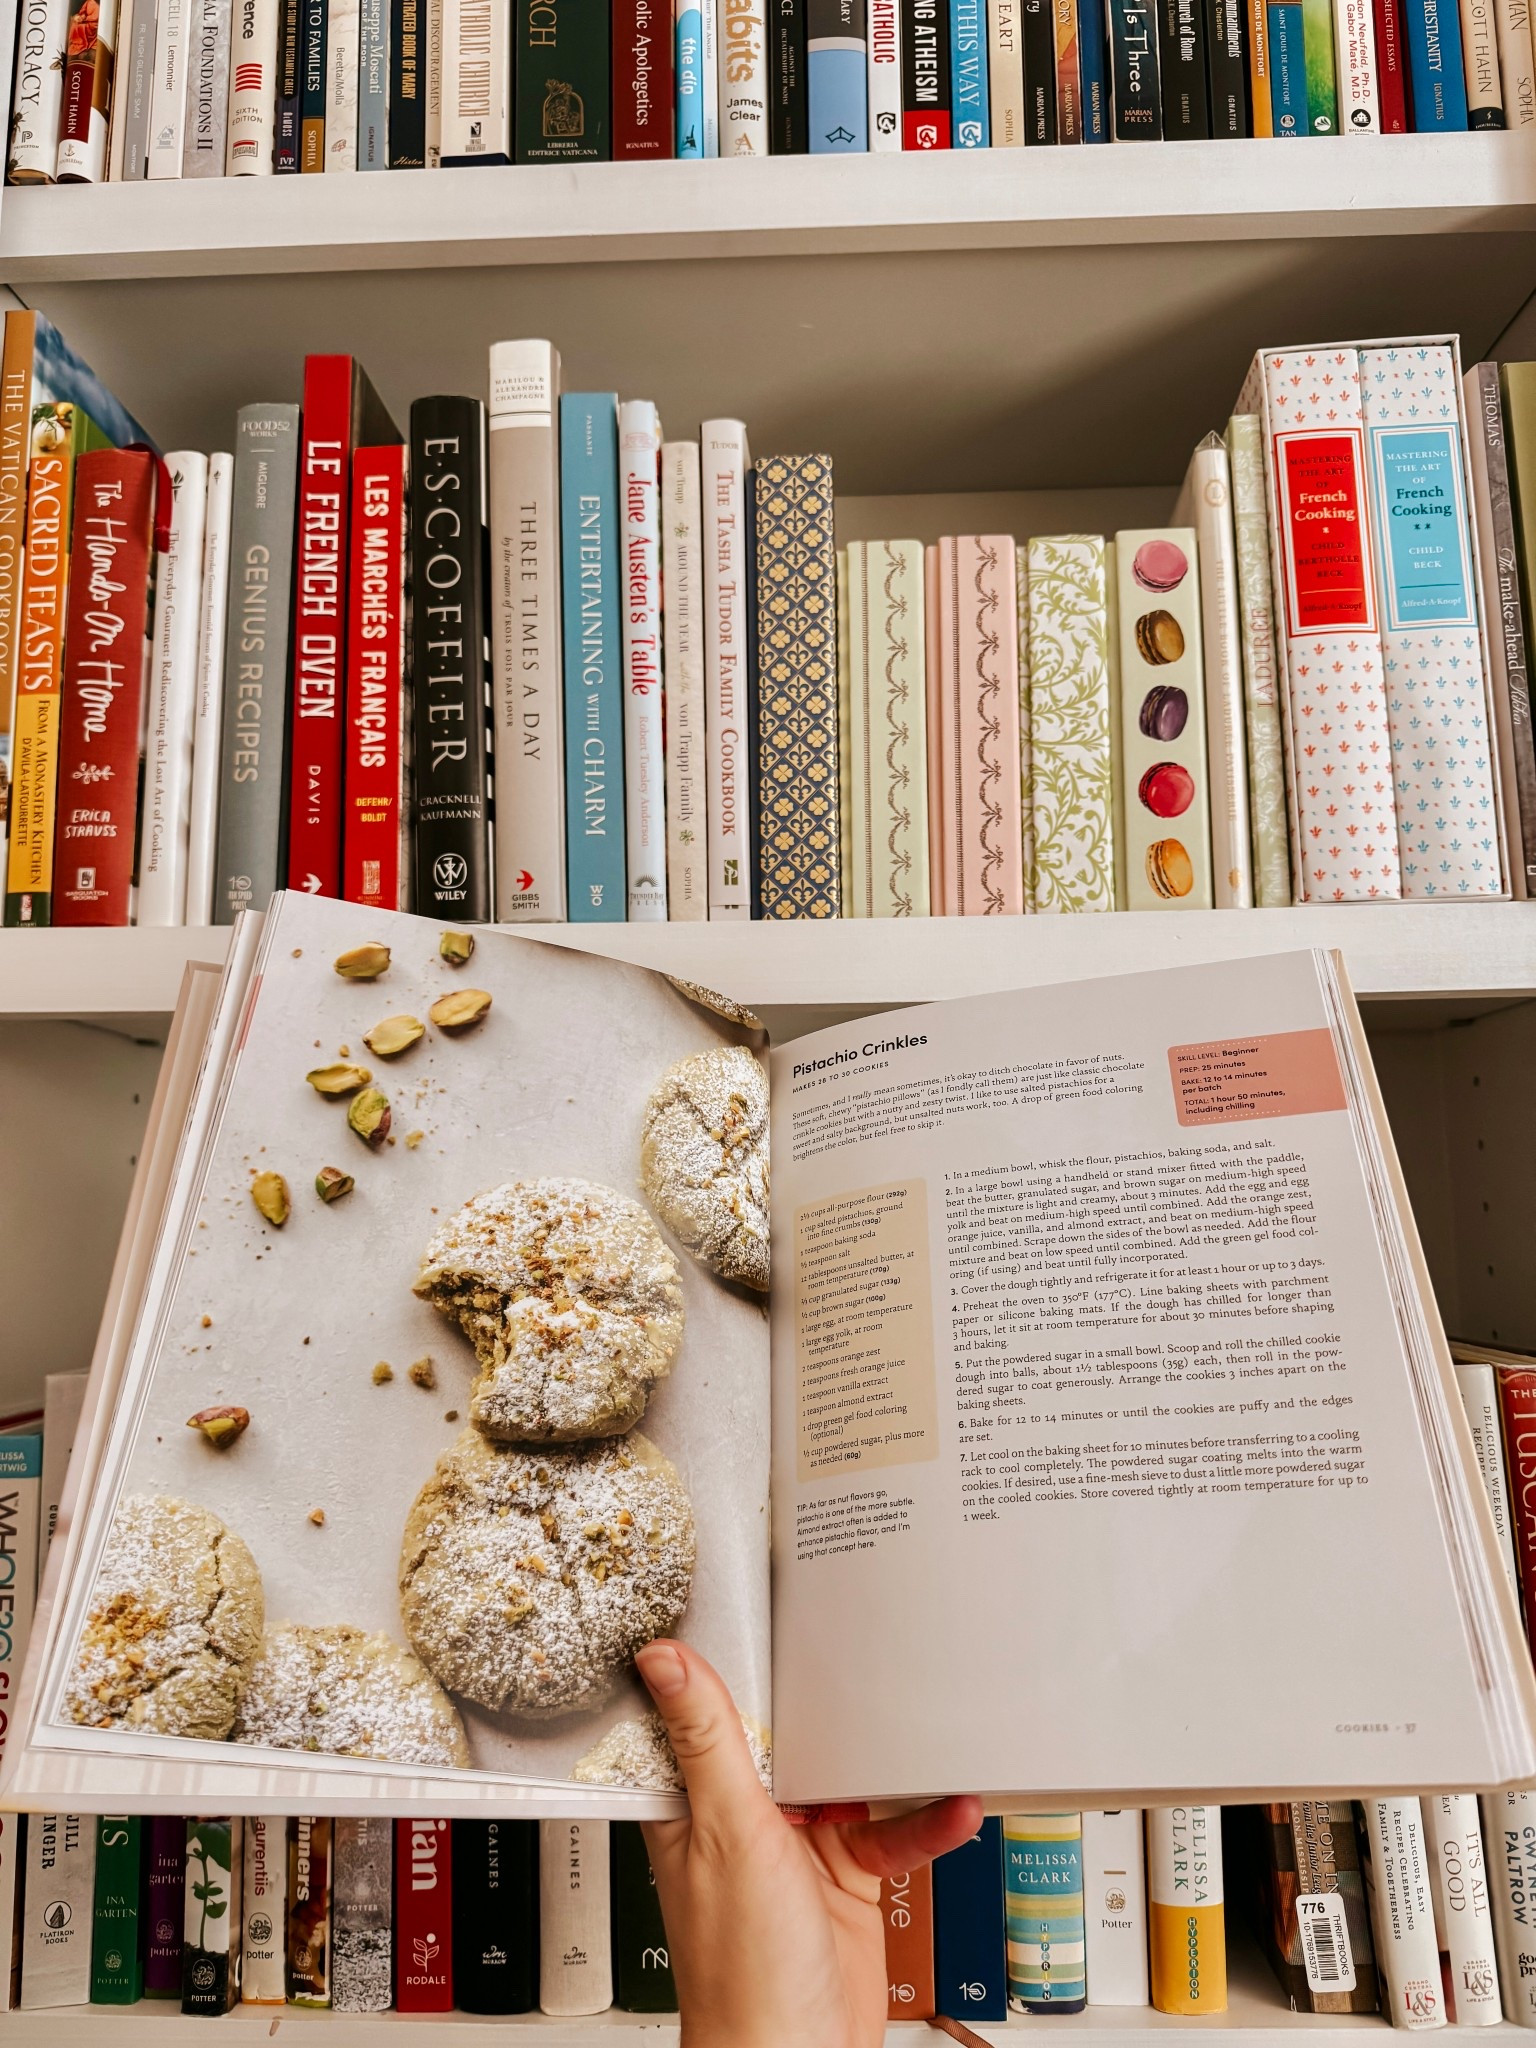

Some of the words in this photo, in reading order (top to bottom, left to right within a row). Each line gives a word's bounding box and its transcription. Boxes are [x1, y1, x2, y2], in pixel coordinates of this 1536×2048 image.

[308, 6, 322, 25] TO
[957, 0, 979, 51] THIS
[1123, 8, 1147, 24] Is
[307, 30, 322, 91] FAMILIES
[681, 37, 697, 65] the
[914, 25, 938, 102] ATHEISM
[1124, 30, 1149, 93] Three
[165, 44, 178, 91] Lemonnier
[632, 34, 652, 126] Apologetics
[681, 70, 698, 95] dip
[959, 57, 980, 106] WAY
[70, 70, 82, 101] SCOTT
[1433, 82, 1445, 120] IGNATIUS
[1517, 77, 1535, 125] SOPHIA
[67, 104, 79, 134] HAHN
[235, 107, 259, 116] SIXTH
[727, 98, 763, 109] James
[729, 111, 760, 121] Clear
[232, 115, 263, 126] EDITION
[1483, 384, 1501, 447] THOMAS
[307, 440, 341, 475] LE
[1386, 450, 1448, 461] MASTERING
[1395, 463, 1418, 473] THE
[1420, 462, 1441, 471] ART
[94, 480, 122, 507] The
[1396, 486, 1444, 499] French
[1412, 476, 1426, 484] OF
[362, 475, 390, 517] LES
[627, 472, 652, 523] Jane
[1391, 503, 1452, 516] Cooking
[30, 459, 63, 577] SACRED
[302, 493, 340, 617] FRENCH
[520, 501, 538, 581] THREE
[1408, 546, 1444, 555] CHILD
[628, 534, 656, 624] Austen's
[1413, 561, 1442, 569] BECK
[84, 517, 127, 653] Hands-On
[240, 544, 270, 652] GENIUS
[360, 528, 394, 639] MARCHÉS
[579, 496, 604, 685] ENTERTAINING
[23, 584, 57, 690] FEASTS
[521, 594, 540, 671] TIMES
[1500, 577, 1525, 671] make-ahead
[299, 634, 336, 719] OVEN
[631, 634, 657, 696] Table
[77, 660, 125, 742] Home
[523, 684, 539, 698] A
[354, 651, 388, 767] FRANÇAIS
[586, 693, 600, 731] WITH
[36, 737, 48, 748] A
[523, 713, 540, 760] DAY
[307, 765, 321, 825] DAVIS
[356, 796, 393, 807] DEFEHR/
[420, 794, 482, 807] CRACKNELL
[583, 738, 606, 836] CHARM
[71, 809, 111, 823] ERICA
[360, 812, 388, 823] BOLDT
[421, 810, 481, 822] KAUFMANN
[64, 825, 118, 839] STRAUSS
[434, 890, 467, 900] WILEY
[512, 894, 539, 902] GIBBS
[512, 902, 539, 910] SMITH
[792, 1049, 858, 1079] Pistachio
[862, 1034, 928, 1057] Crinkles
[1179, 1066, 1200, 1074] PREP:
[1213, 1061, 1246, 1070] minutes
[1222, 1047, 1259, 1057] Beginner
[792, 1080, 816, 1094] MAKES
[829, 1073, 839, 1082] TO
[841, 1070, 851, 1079] 30
[852, 1060, 889, 1075] COOKIES
[1181, 1078, 1202, 1086] BAKE:
[1235, 1070, 1267, 1080] minutes
[1182, 1087, 1197, 1095] per
[1198, 1084, 1222, 1093] batch
[1184, 1098, 1209, 1106] TOTAL:
[1216, 1094, 1236, 1103] hour
[1250, 1089, 1286, 1099] minutes,
[1185, 1105, 1224, 1115] including
[1225, 1101, 1256, 1111] chilling
[944, 1173, 951, 1181] 1.
[953, 1171, 963, 1180] In
[971, 1165, 1009, 1178] medium
[1010, 1161, 1037, 1173] bowl,
[1039, 1158, 1067, 1170] whisk
[1069, 1157, 1084, 1167] the
[1086, 1155, 1112, 1166] flour,
[1114, 1150, 1166, 1164] pistachios,
[1167, 1147, 1203, 1158] baking
[1204, 1143, 1231, 1154] soda,
[1232, 1140, 1252, 1151] and
[1254, 1138, 1276, 1150] salt.
[1482, 1405, 1498, 1473] DELICIOUS
[1490, 1477, 1505, 1538] WEEKDAY
[488, 1823, 499, 1888] GAINES
[569, 1825, 580, 1890] GAINES
[1011, 1852, 1078, 1865] MELISSA
[1171, 1808, 1189, 1890] CLARK
[1018, 1871, 1071, 1883] CLARK
[1443, 1840, 1466, 1912] GOOD
[1504, 1830, 1529, 1925] PALTROW
[95, 1908, 137, 1918] GARTEN
[106, 1895, 125, 1905] INA
[1301, 1902, 1325, 1914] 776
[1471, 1877, 1487, 1918] ALL
[40, 1930, 75, 1939] FLATIRON
[1101, 1919, 1133, 1929] Potter
[45, 1936, 69, 1944] BOOKS
[246, 1950, 274, 1960] potter
[1332, 1913, 1350, 1976] THRIFTBOOKS
[1039, 1922, 1052, 2000] HYPERION
[1187, 1916, 1200, 2000] HYPERION
[406, 1975, 447, 1985] RODALE
[191, 1994, 217, 2002] POTTER
